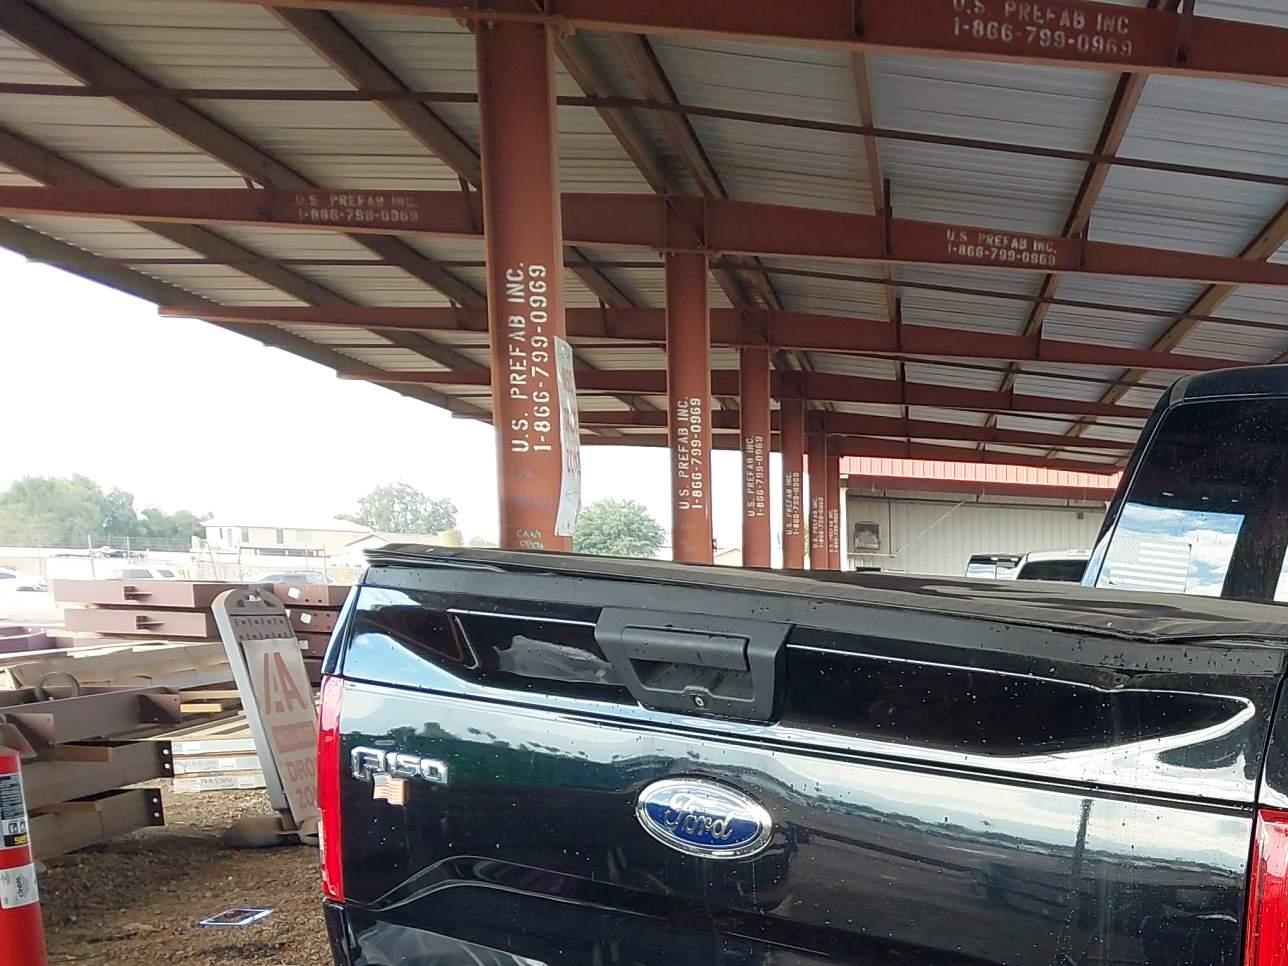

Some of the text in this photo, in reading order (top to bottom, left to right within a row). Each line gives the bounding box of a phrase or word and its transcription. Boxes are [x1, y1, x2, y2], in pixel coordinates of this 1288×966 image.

[953, 16, 1132, 57] 1-866-799-0969
[1004, 1, 1086, 29] PREFAB
[505, 262, 530, 452] U.S. PREFAB INC.
[528, 264, 552, 452] 1-866-799-0969
[677, 427, 690, 479] PREFAB
[690, 397, 703, 510] 1-866-799-0969
[287, 757, 316, 782] DRO
[663, 792, 734, 840] Ford
